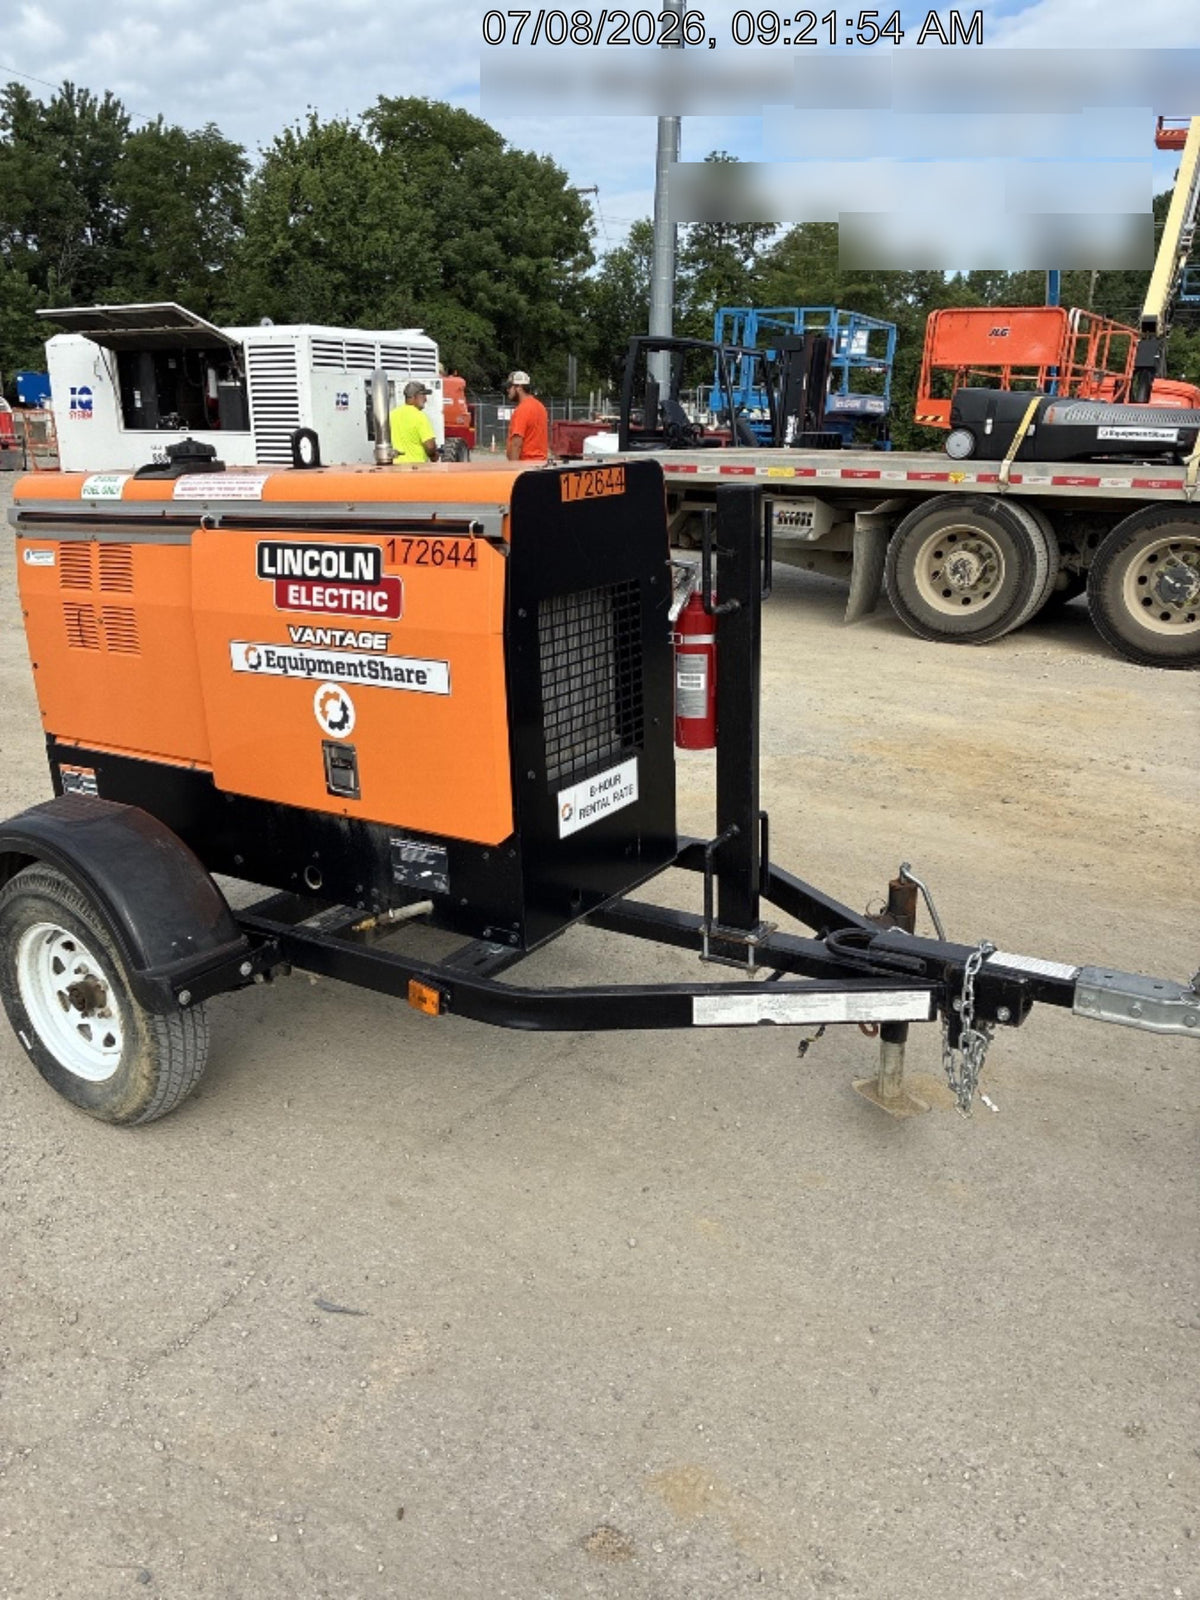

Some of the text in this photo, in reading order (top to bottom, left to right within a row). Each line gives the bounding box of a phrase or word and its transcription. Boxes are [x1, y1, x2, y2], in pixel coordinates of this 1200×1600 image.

[69, 385, 93, 411] IQ
[562, 466, 625, 500] 172644
[263, 547, 374, 580] LINCOLN
[387, 538, 477, 567] 172644
[288, 584, 388, 612] ELECTRIC
[287, 624, 388, 651] VANTAGE
[264, 649, 428, 685] EquipmentShare
[579, 783, 634, 820] RENTAL RATE
